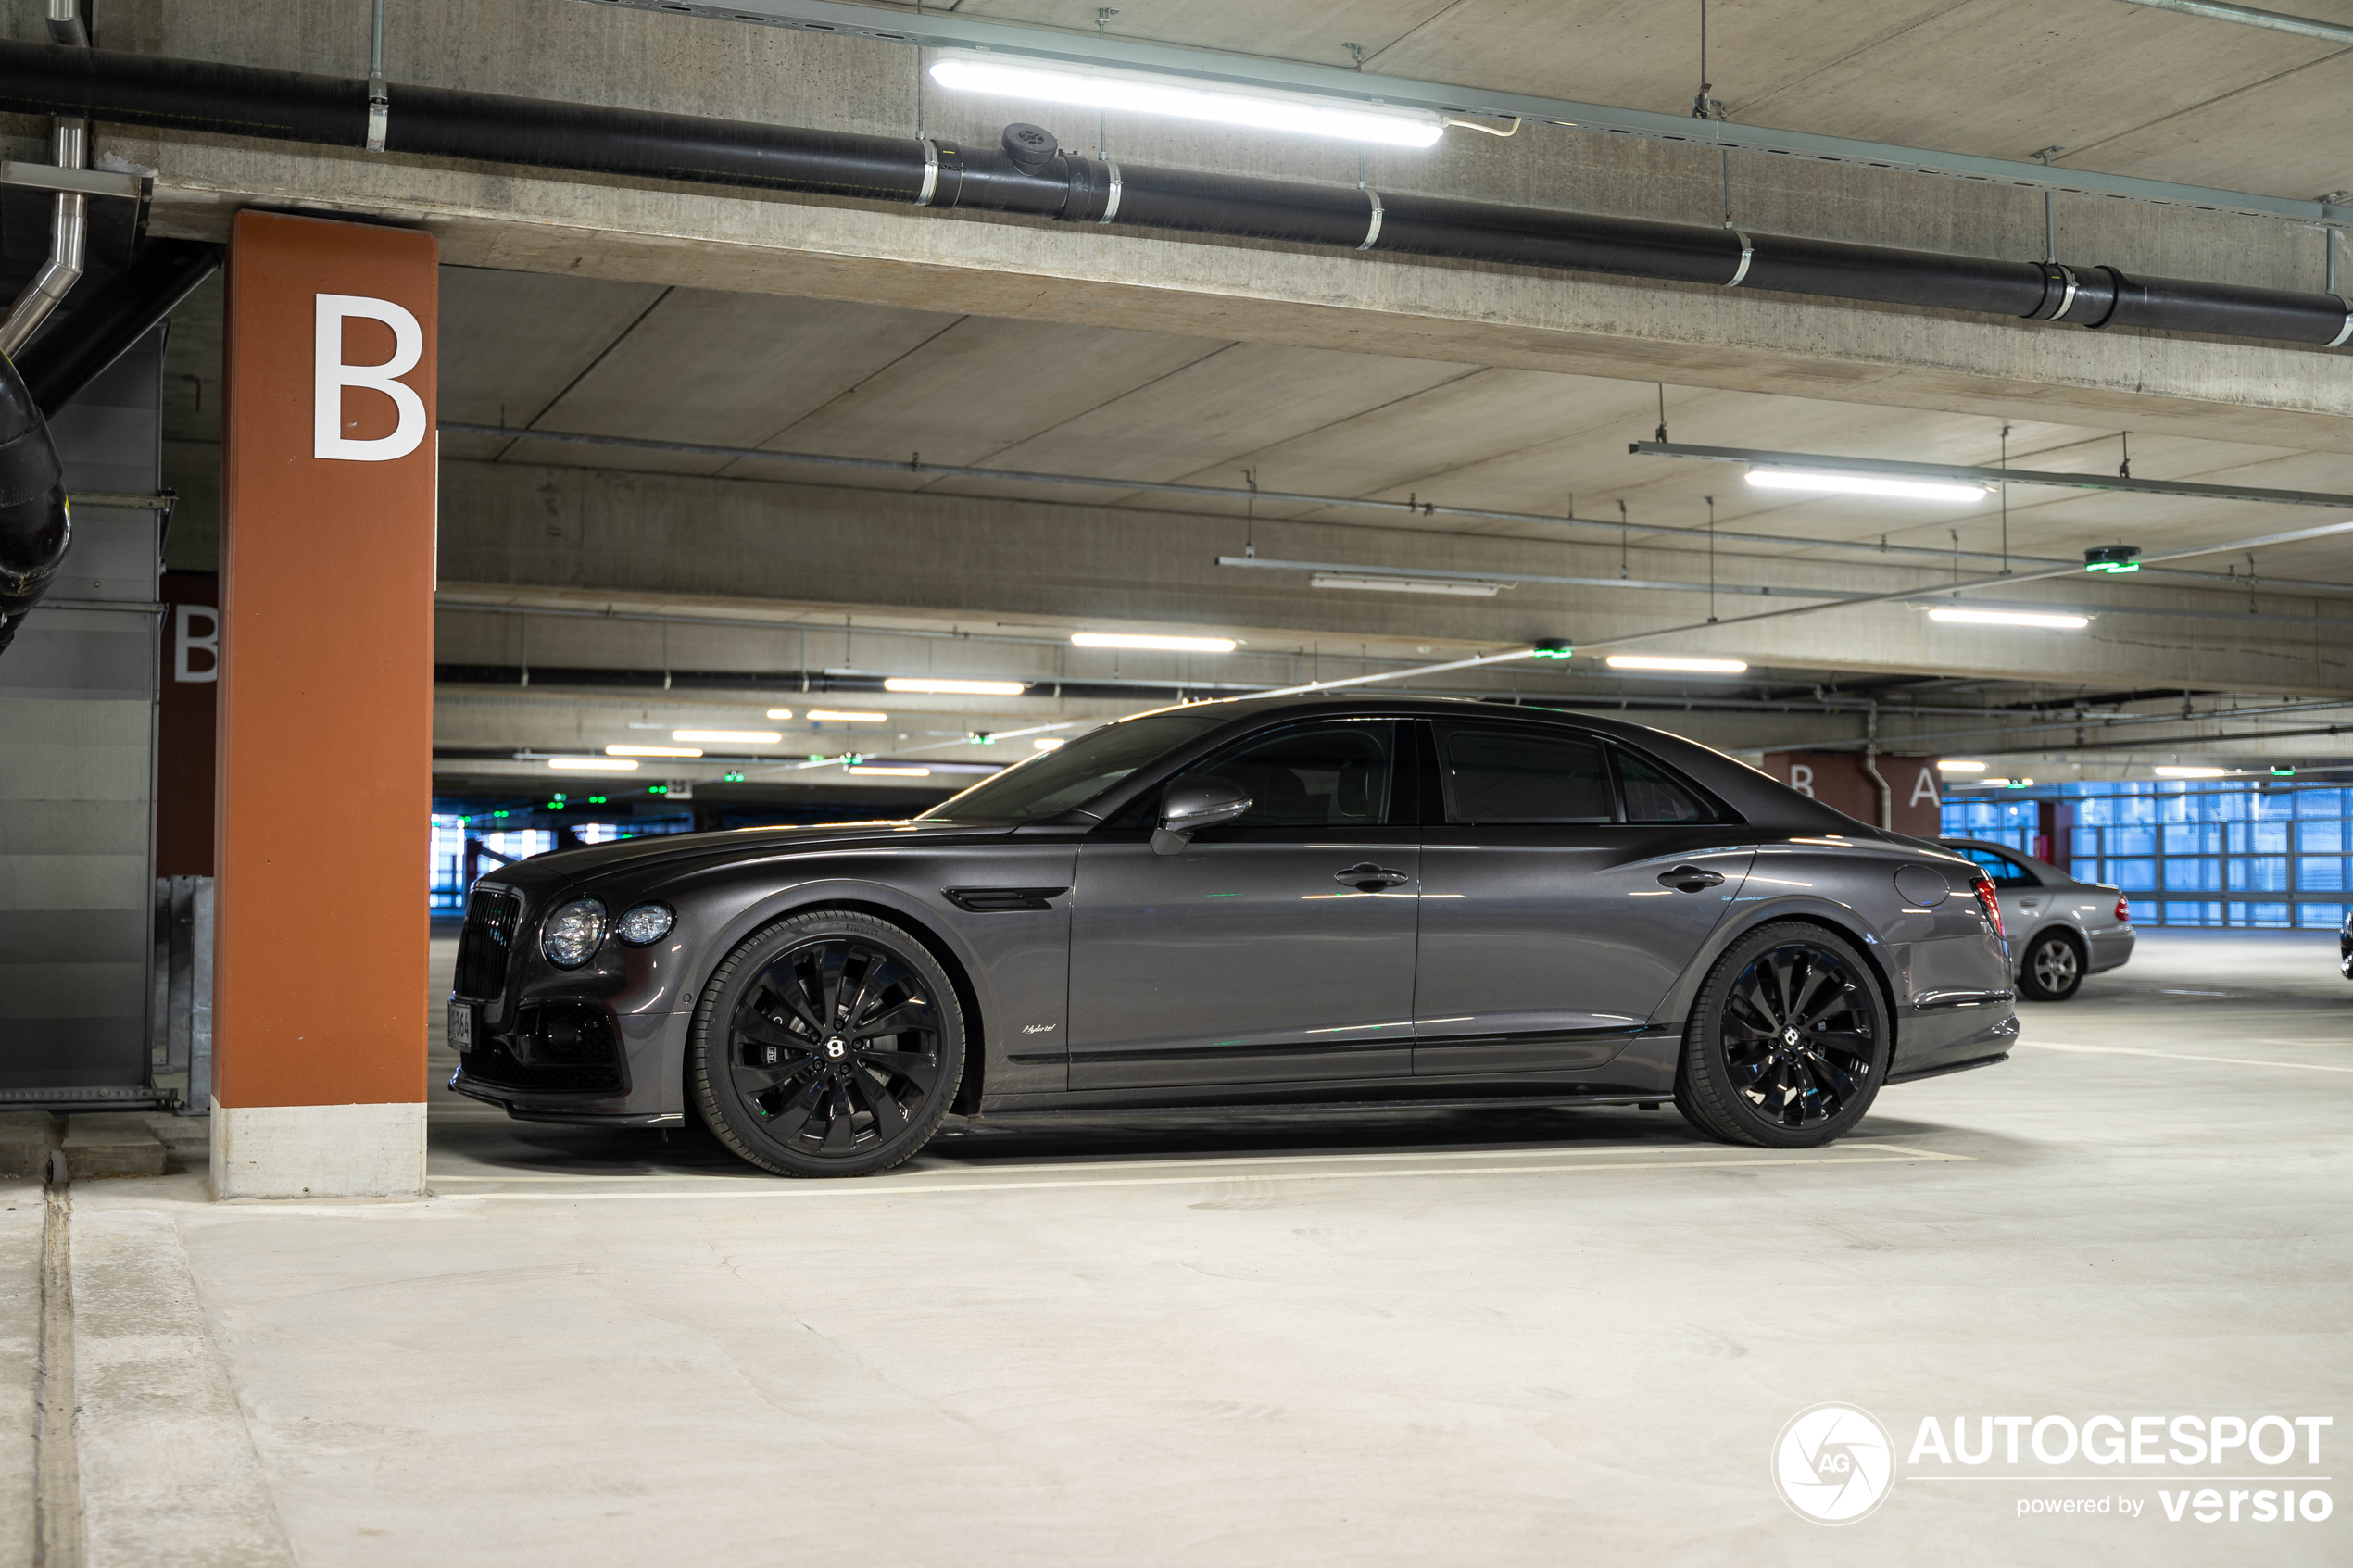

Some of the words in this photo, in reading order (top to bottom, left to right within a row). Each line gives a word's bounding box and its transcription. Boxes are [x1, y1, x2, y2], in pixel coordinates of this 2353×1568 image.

[315, 293, 427, 461] B
[174, 603, 219, 683] B
[1790, 764, 1815, 798] B
[1908, 767, 1942, 808] A
[1022, 1023, 1056, 1035] Hybrid
